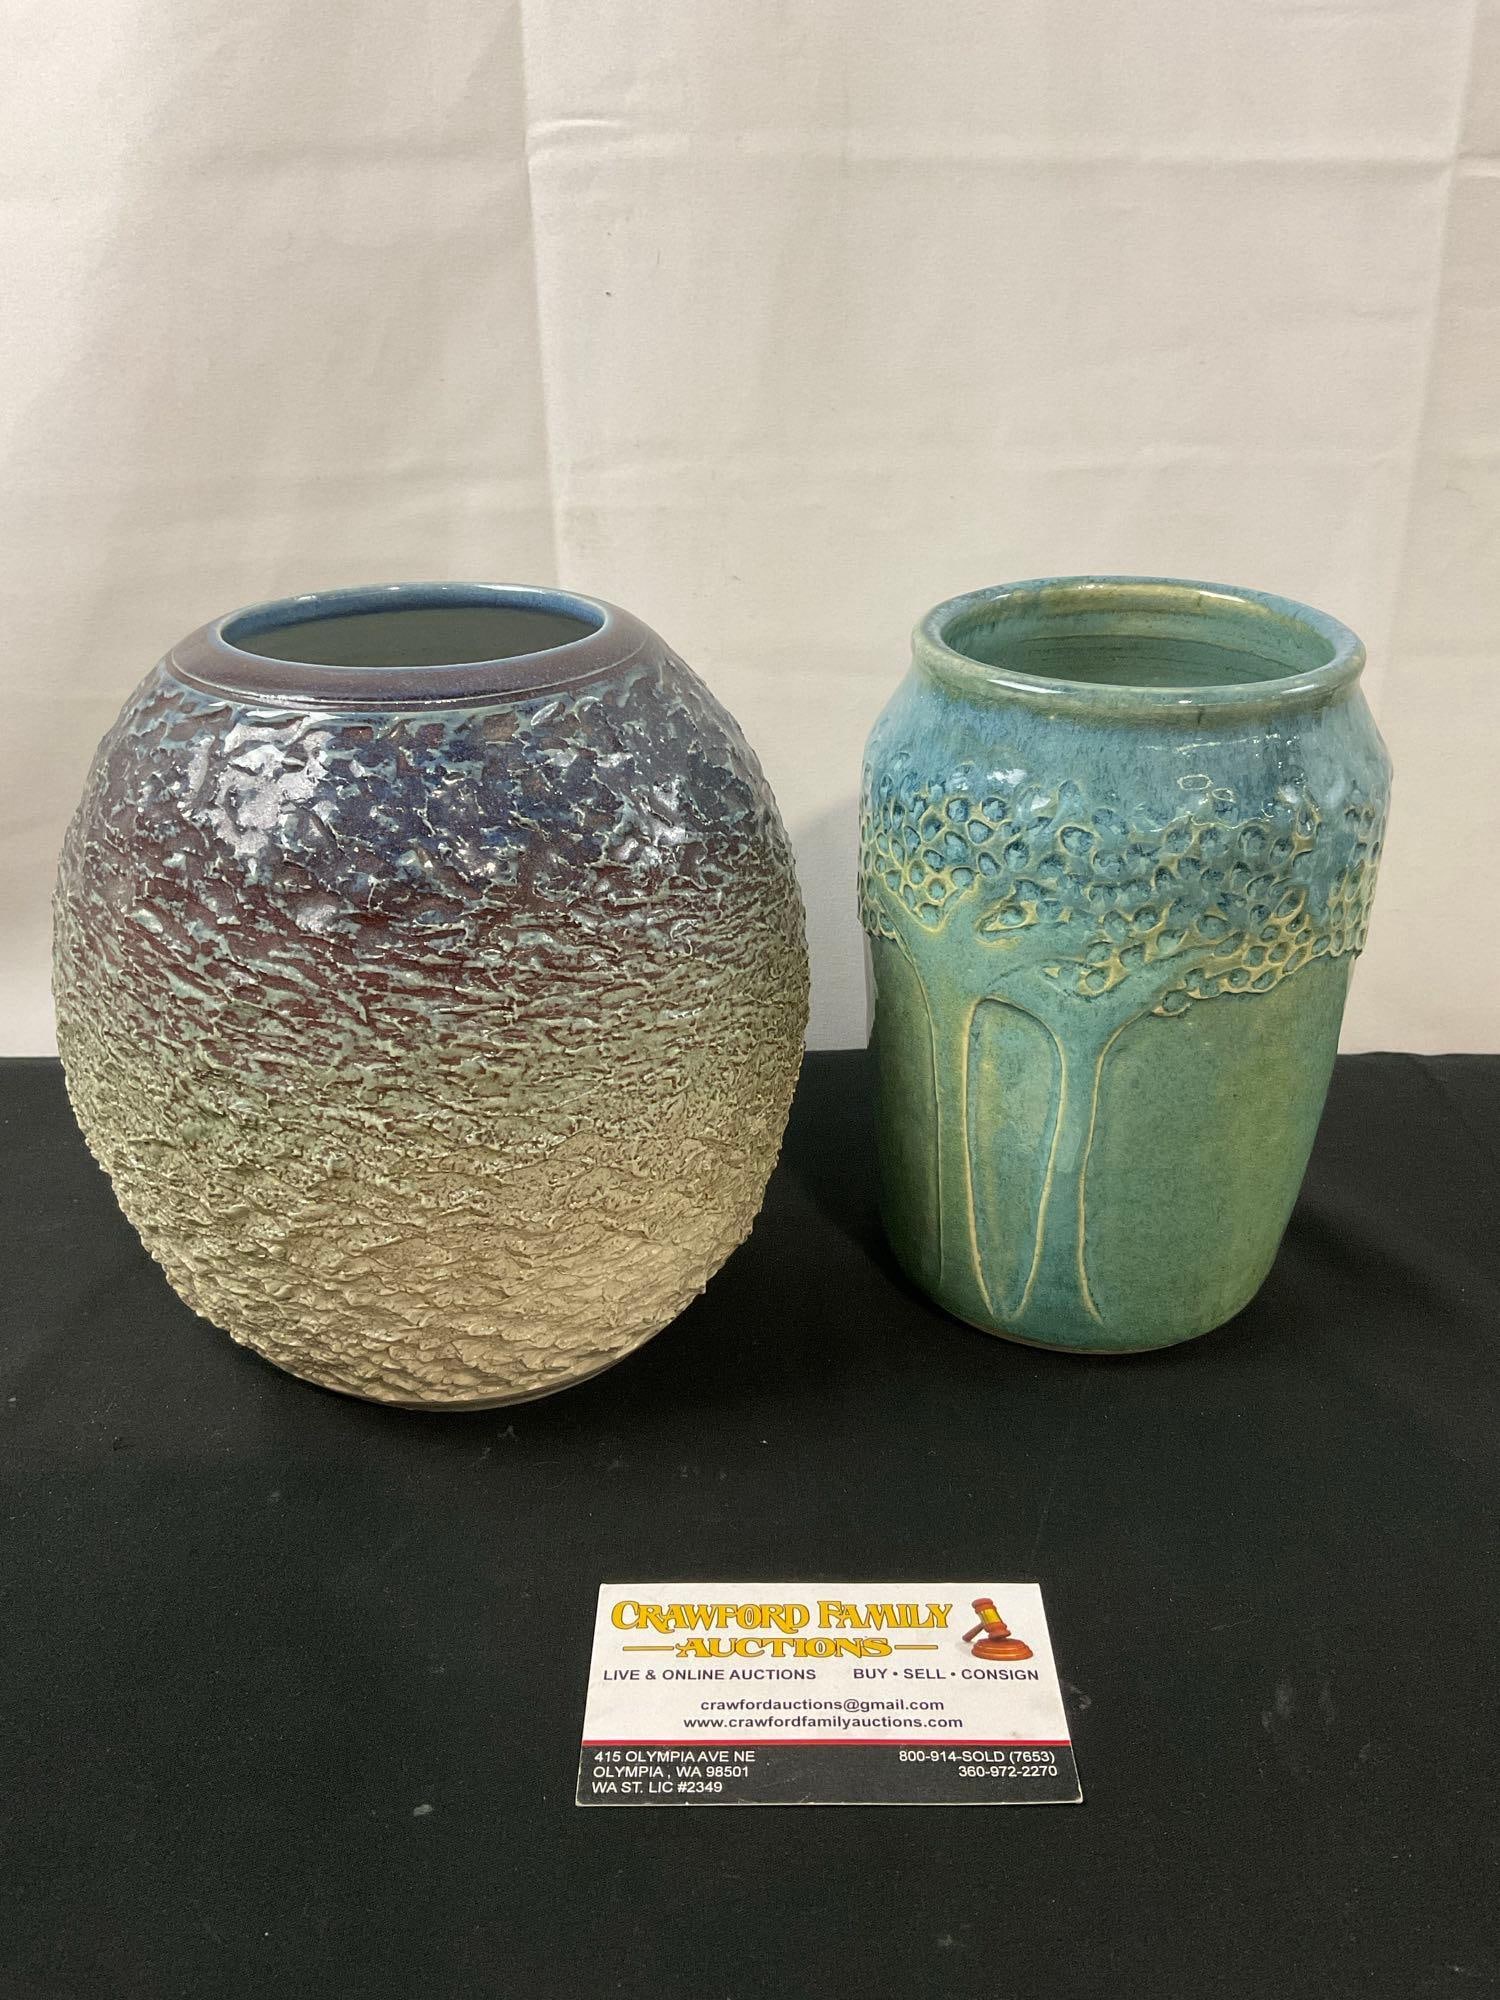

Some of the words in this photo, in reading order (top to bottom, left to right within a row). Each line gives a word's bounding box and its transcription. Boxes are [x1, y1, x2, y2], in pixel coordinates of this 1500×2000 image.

[611, 1600, 810, 1634] CRAWFORD
[818, 1600, 953, 1629] FAMILY
[675, 1637, 892, 1658] AUCTIONS
[603, 1669, 640, 1681] LIVE
[645, 1669, 657, 1680] &
[663, 1669, 725, 1680] ONLINE
[729, 1669, 816, 1680] AUCTIONS
[853, 1668, 887, 1679] BUY
[904, 1669, 946, 1680] SELL
[962, 1669, 1039, 1680] CONSIGN
[700, 1698, 944, 1712] crawfordauctions@gmail.com
[683, 1716, 963, 1730] www.crawfordfamilyauctions.com
[595, 1751, 622, 1762] 415
[625, 1751, 696, 1762] OLYMPIA
[699, 1751, 730, 1762] AVE
[736, 1751, 755, 1762] NE
[899, 1751, 1005, 1762] 800-914-SOLD
[1009, 1751, 1054, 1764] (7653)
[676, 1766, 700, 1777] WA
[705, 1766, 749, 1777] 98501
[958, 1765, 1057, 1777] 360-972-2270
[592, 1782, 617, 1793] WA
[620, 1782, 644, 1793] ST.
[649, 1782, 674, 1793] LIC
[678, 1781, 722, 1793] #2349
